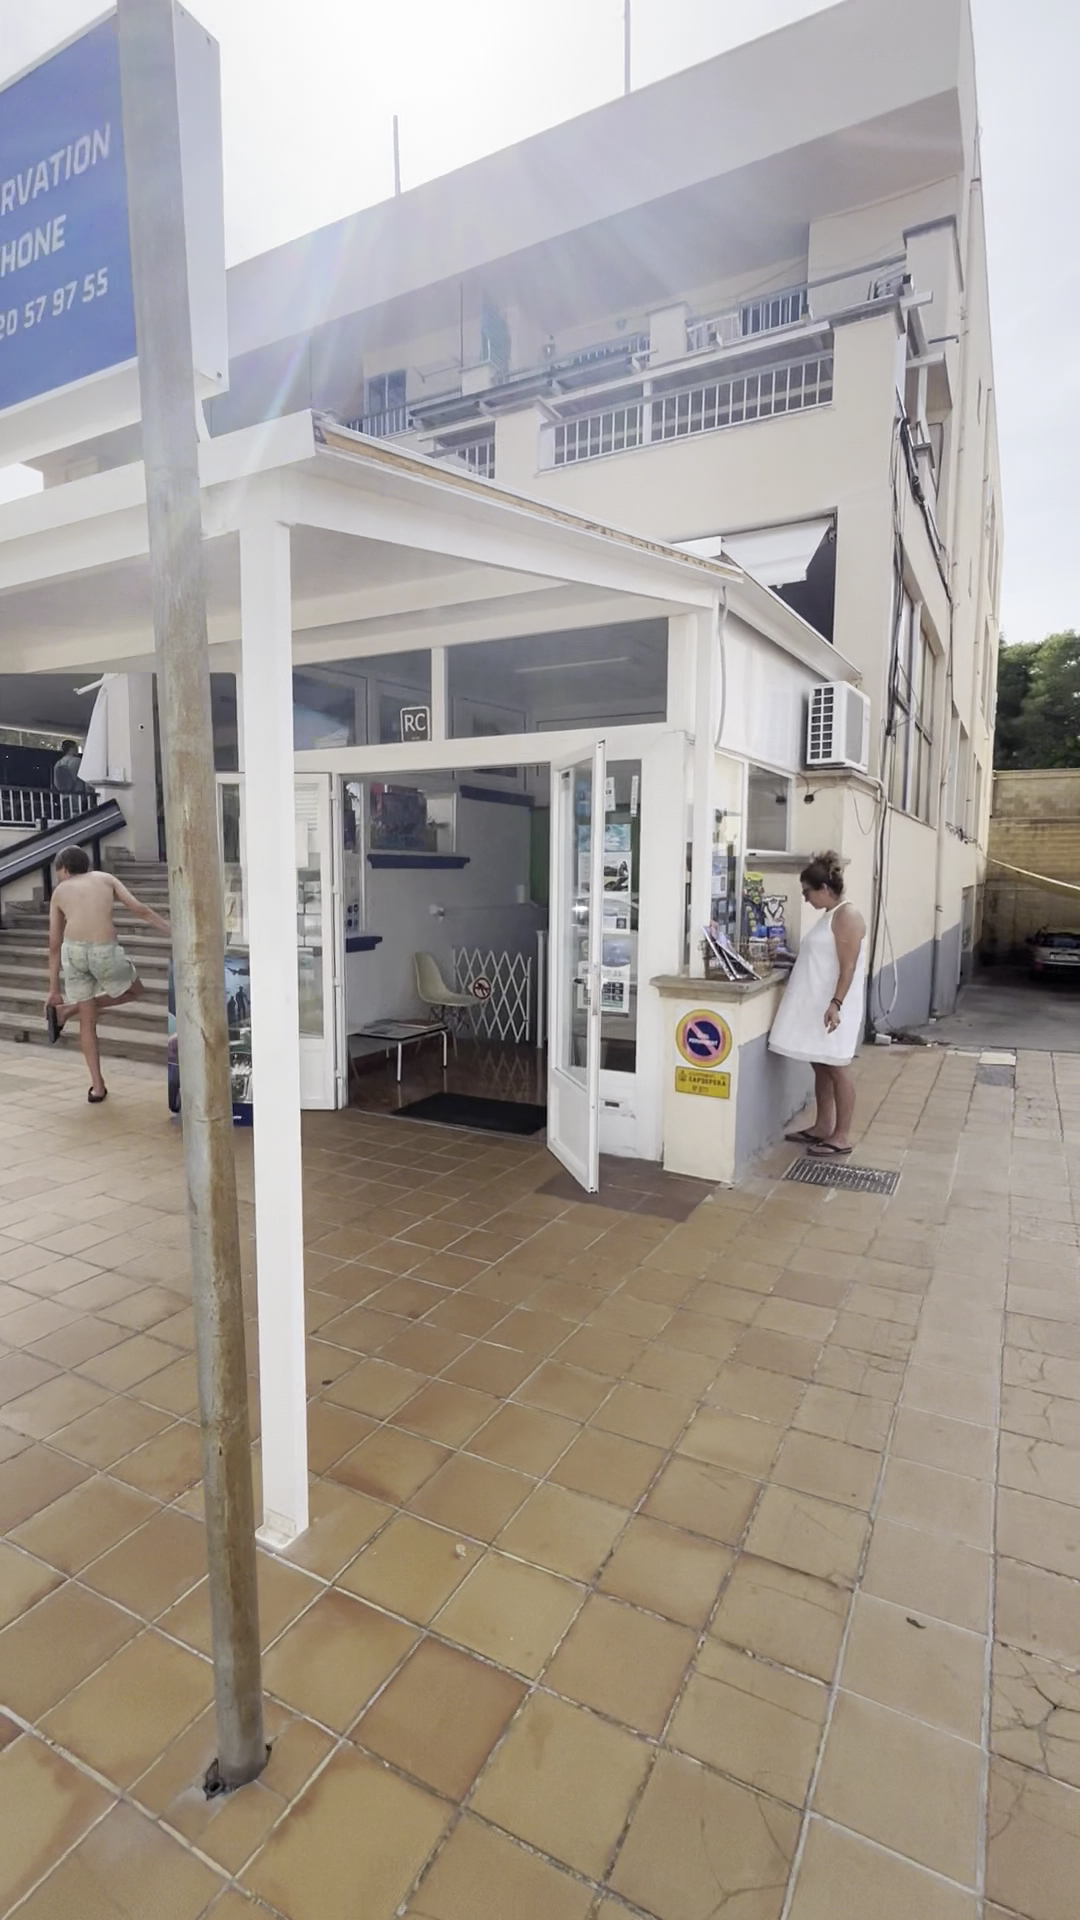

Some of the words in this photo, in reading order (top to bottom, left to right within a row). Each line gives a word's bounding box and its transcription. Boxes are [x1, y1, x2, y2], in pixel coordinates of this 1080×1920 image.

[1, 122, 110, 216] RVATION
[1, 214, 67, 277] HONE
[24, 296, 47, 328] 57
[52, 281, 78, 316] 97
[82, 267, 108, 302] 55
[404, 713, 426, 732] RC
